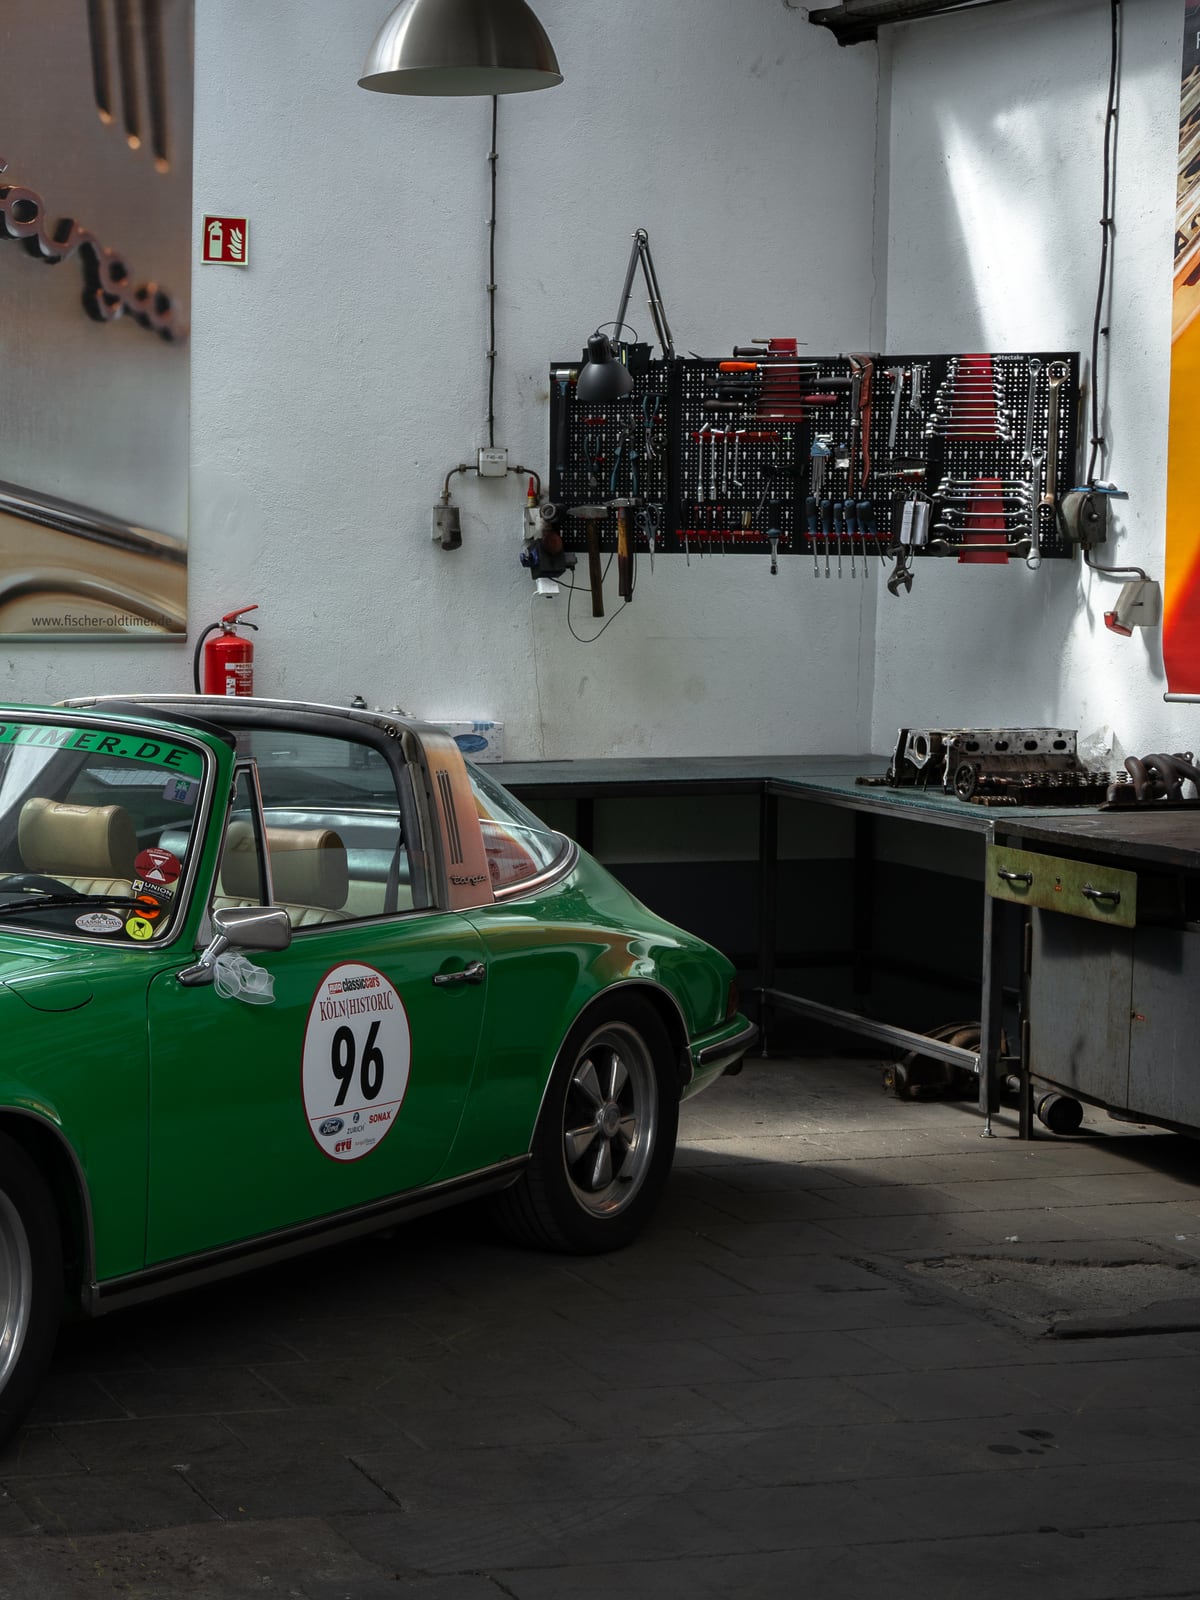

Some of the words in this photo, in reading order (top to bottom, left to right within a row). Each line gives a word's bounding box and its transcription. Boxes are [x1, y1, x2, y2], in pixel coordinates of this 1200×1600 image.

[31, 614, 172, 627] www.fischer-oldtimer.de
[144, 881, 173, 897] UNION
[331, 1020, 384, 1107] 96
[368, 1110, 392, 1124] SONAX
[347, 1124, 365, 1134] ZURICH
